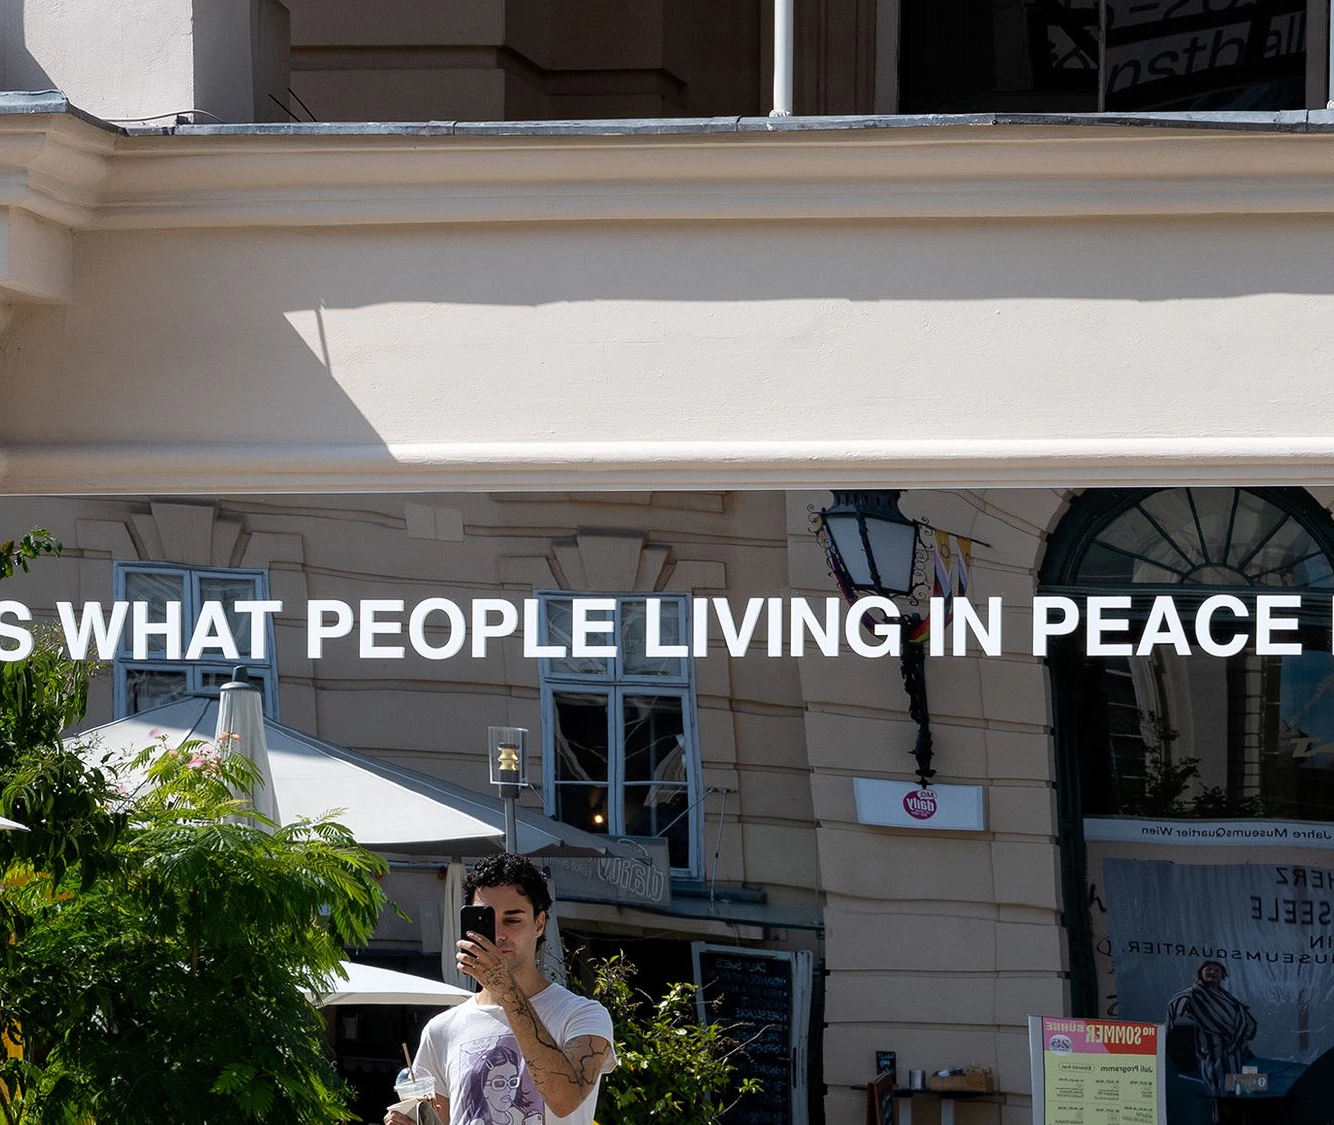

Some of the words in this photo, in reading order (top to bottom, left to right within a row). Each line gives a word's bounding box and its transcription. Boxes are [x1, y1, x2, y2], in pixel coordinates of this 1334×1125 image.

[56, 600, 283, 660] WHAT
[307, 597, 618, 660] PEOPLE
[646, 596, 901, 658] LIVING
[929, 596, 1002, 657] IN
[1031, 594, 1303, 656] PEACE
